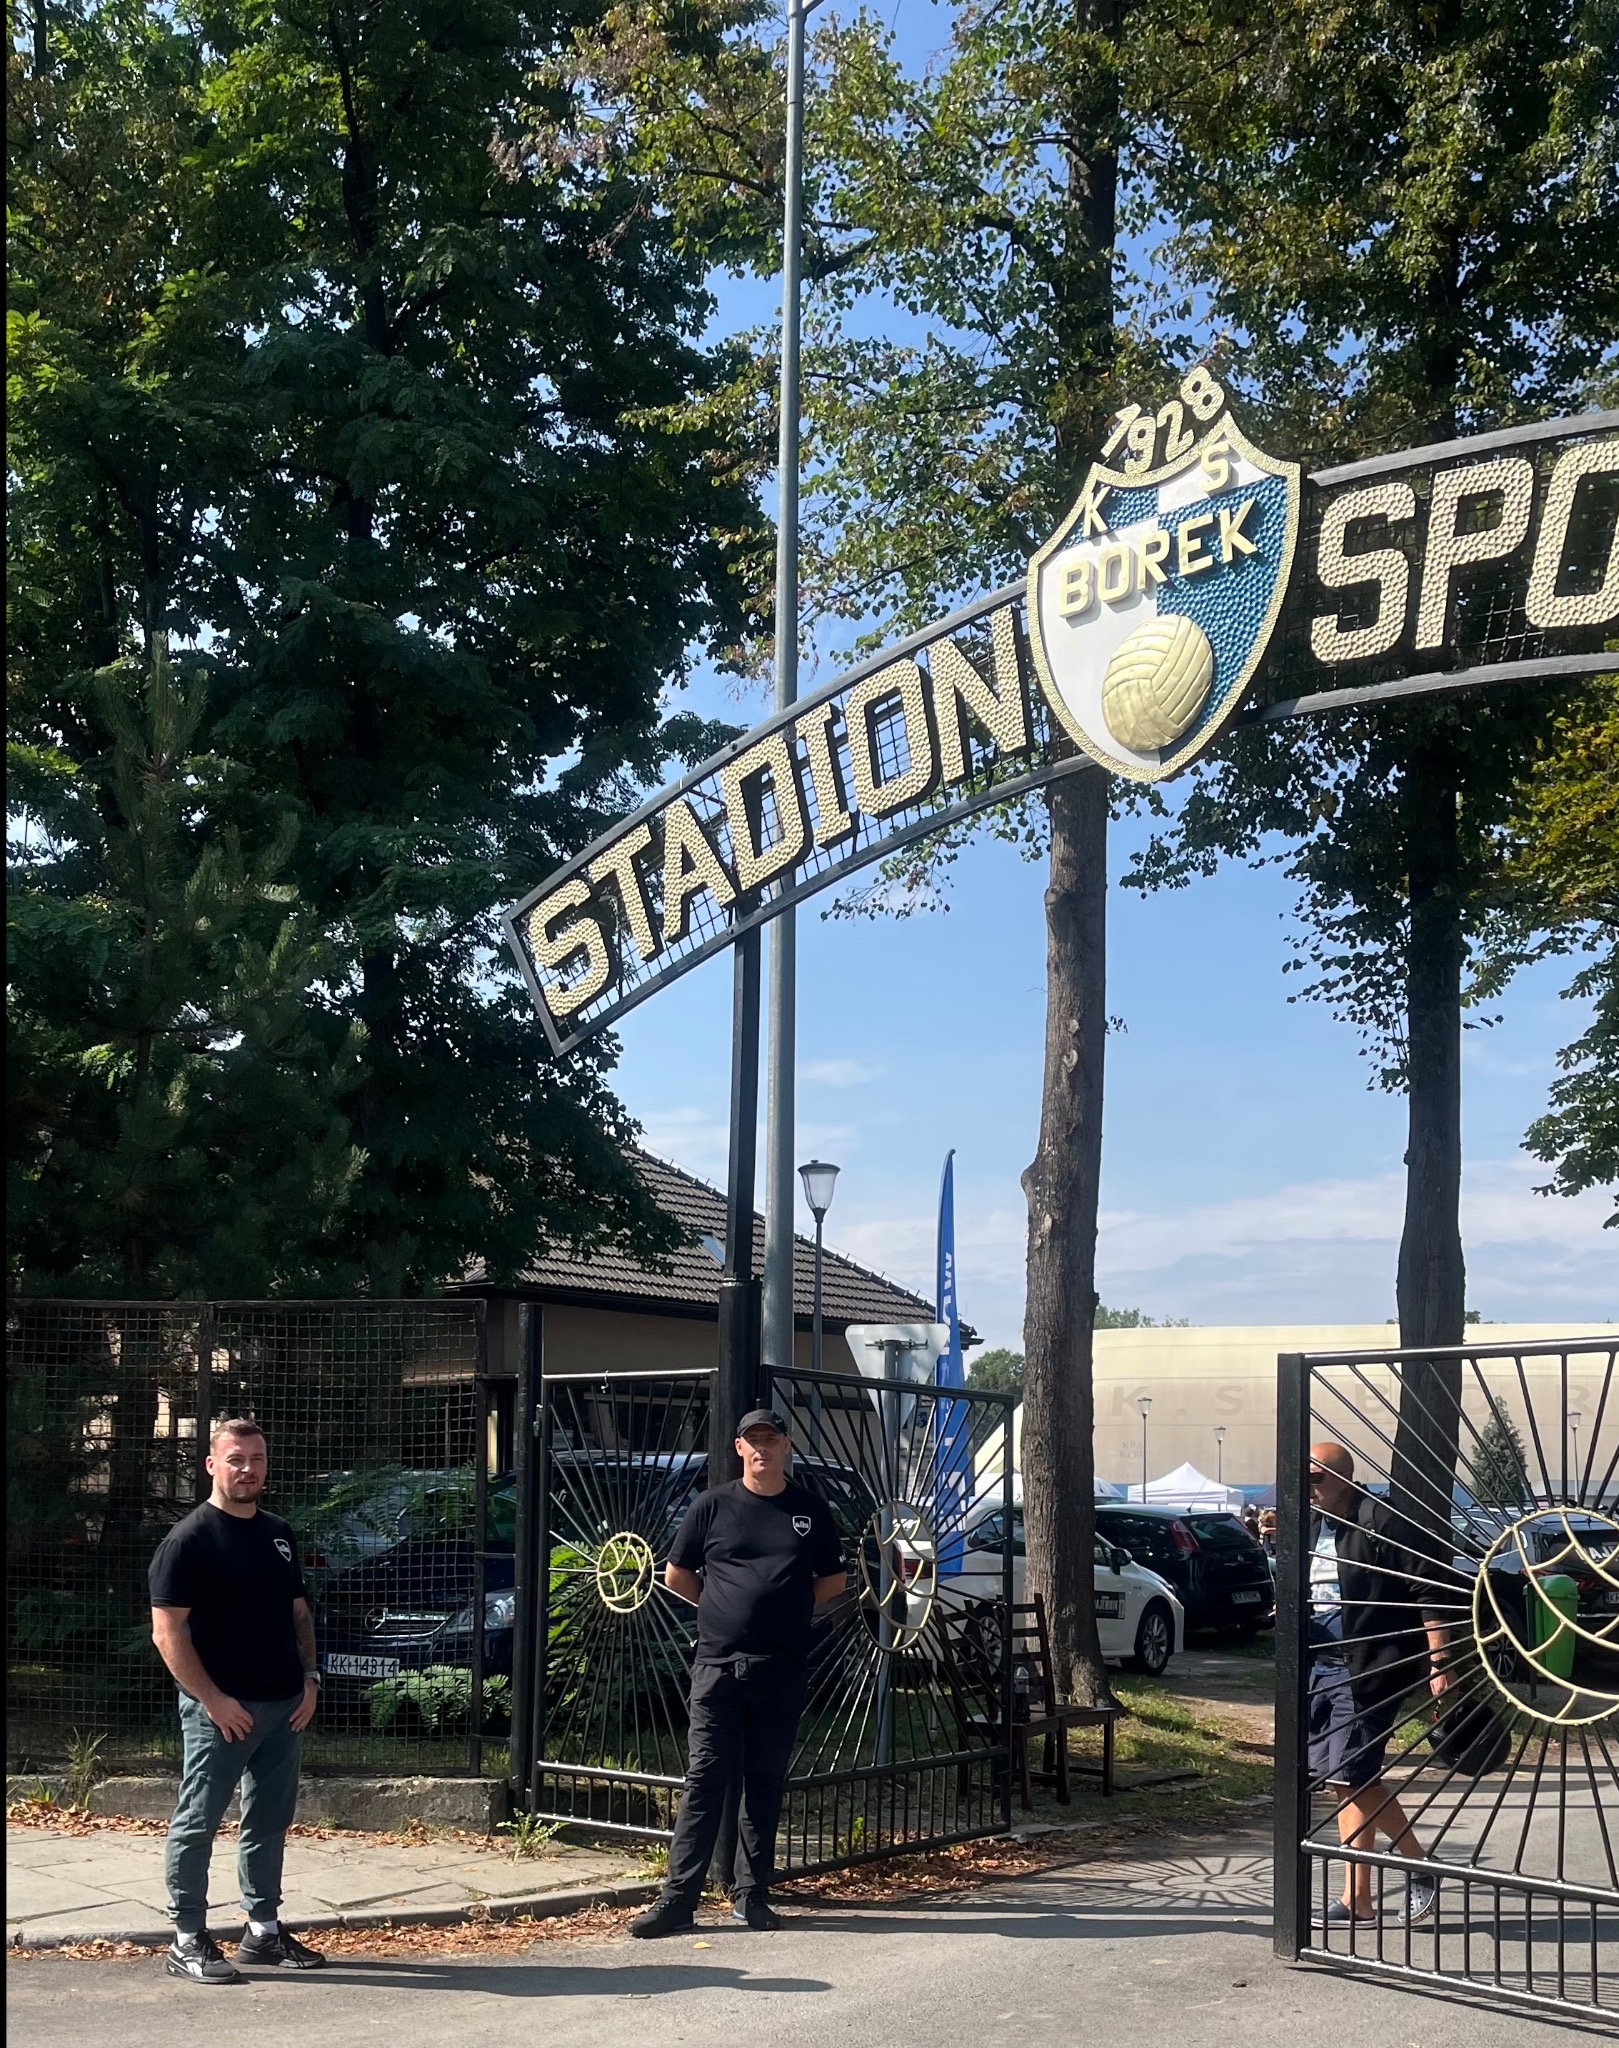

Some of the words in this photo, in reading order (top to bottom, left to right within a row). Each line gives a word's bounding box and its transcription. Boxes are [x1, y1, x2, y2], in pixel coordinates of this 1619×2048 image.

[1101, 366, 1225, 474] 1928
[1200, 439, 1230, 492] S
[1058, 499, 1258, 618] BOREK
[529, 606, 1028, 1017] STADION
[331, 1655, 348, 1673] KK
